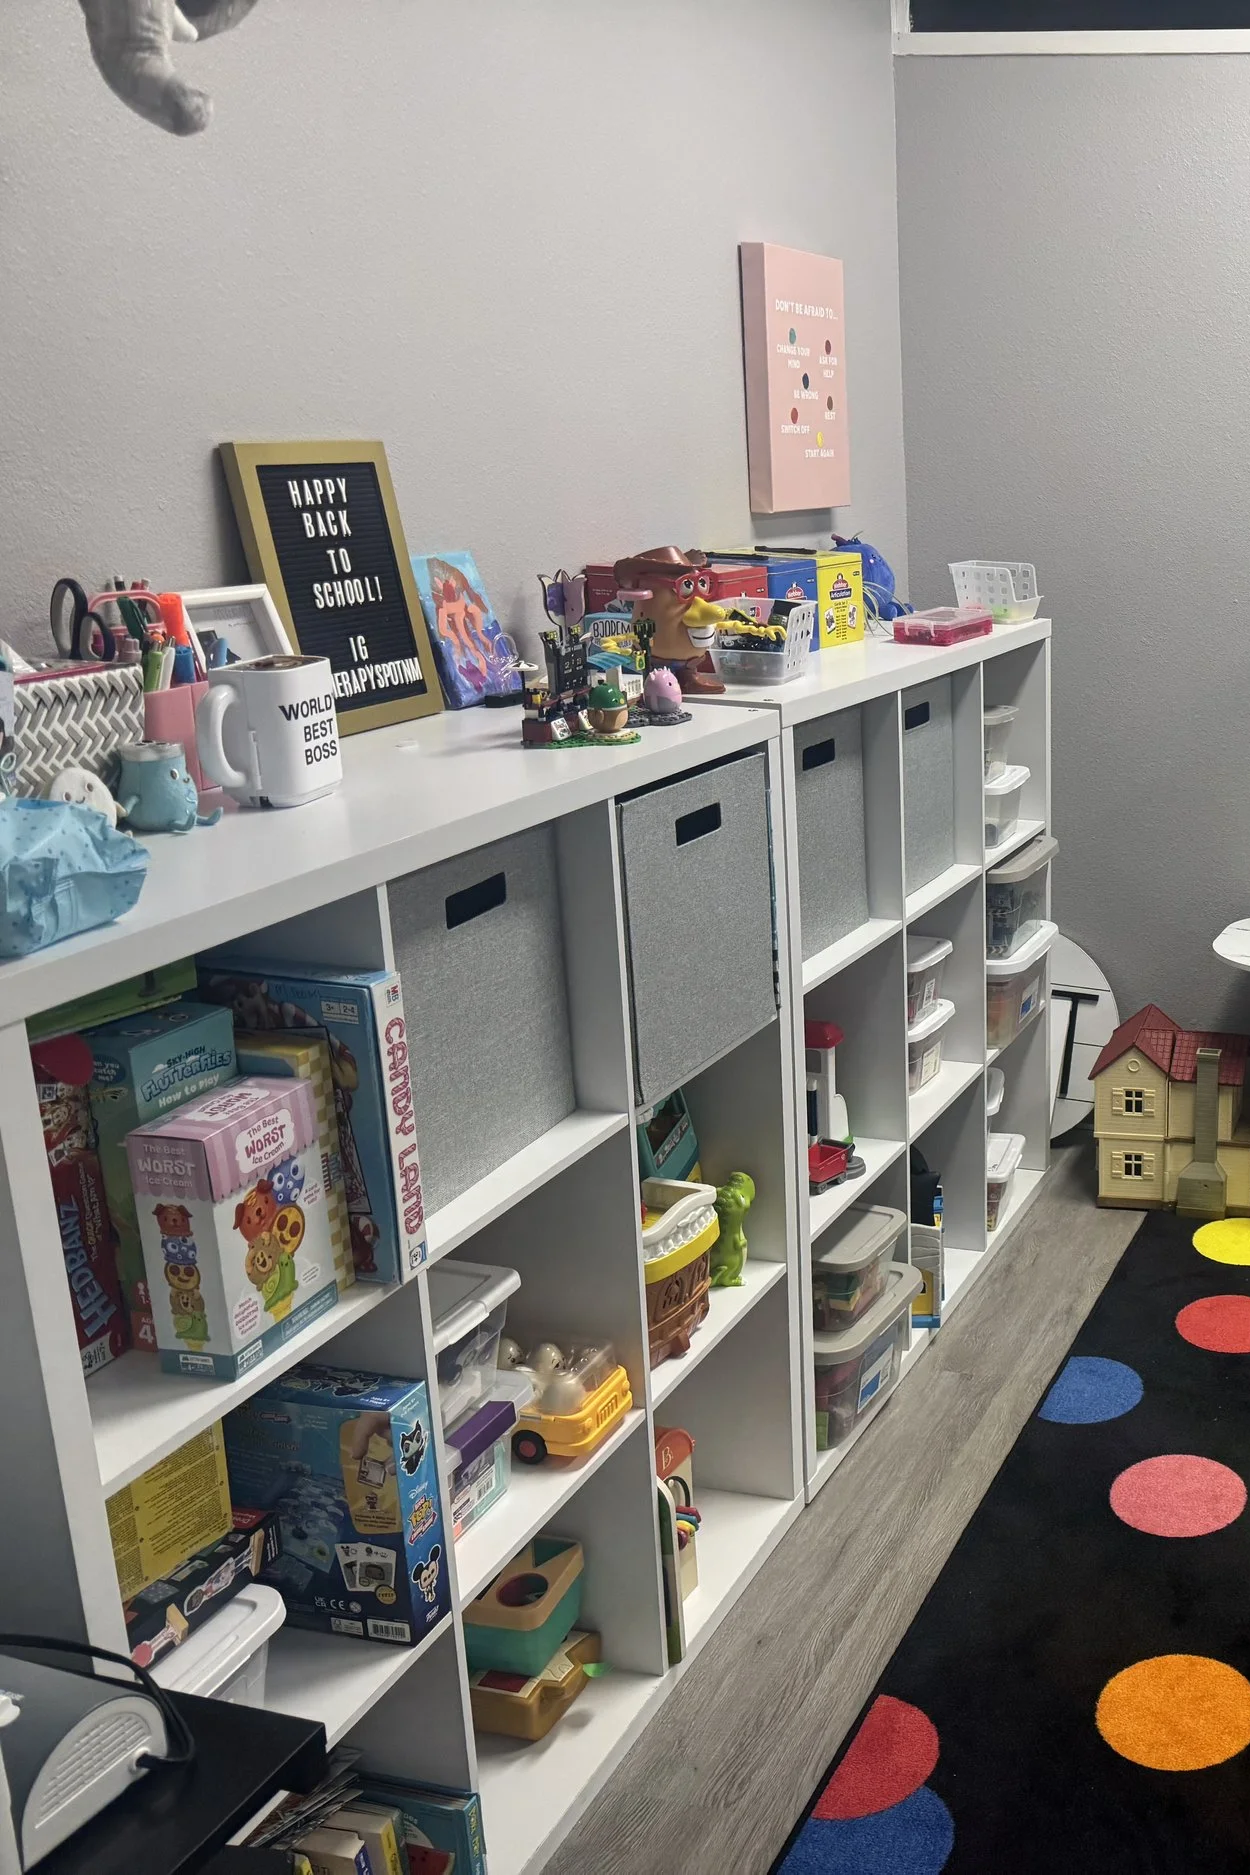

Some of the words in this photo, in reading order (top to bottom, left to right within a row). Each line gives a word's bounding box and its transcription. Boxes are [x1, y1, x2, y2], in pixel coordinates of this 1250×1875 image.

[775, 299, 794, 315] DON'T
[795, 303, 803, 315] BE
[804, 304, 824, 318] AFRAID
[776, 344, 797, 356] CHANGE
[797, 345, 811, 357] YOUR
[819, 356, 828, 366] ASK
[828, 357, 837, 367] FOR
[787, 358, 800, 369] MIND
[823, 368, 835, 379] HELP
[793, 389, 800, 399] BE
[800, 390, 819, 400] WRONG
[824, 410, 836, 421] REST
[781, 424, 799, 434] SWITCH
[800, 424, 811, 435] OFF
[805, 449, 820, 458] START
[820, 449, 835, 458] AGAIN
[287, 477, 348, 508] HAPPY
[302, 510, 351, 538] BACK
[326, 548, 351, 574] TO
[312, 576, 383, 609] SCHOOL!
[349, 635, 369, 663] IG
[303, 717, 334, 743] BEST
[304, 740, 338, 766] BOSS
[384, 1017, 415, 1136] CANDY
[158, 1092, 182, 1109] How
[184, 1084, 197, 1095] to
[200, 1073, 220, 1091] Play
[247, 1125, 262, 1139] The
[262, 1115, 279, 1132] Best
[143, 1143, 161, 1153] The
[163, 1145, 185, 1155] Best
[244, 1123, 286, 1159] WORST
[252, 1154, 264, 1165] Ice
[263, 1141, 285, 1161] Cream
[136, 1158, 196, 1176] WORST
[144, 1175, 162, 1185] Ice
[162, 1176, 193, 1188] Cream
[398, 1143, 424, 1235] LAND
[58, 1192, 117, 1338] HEDBANZ
[408, 1480, 428, 1499] Disney
